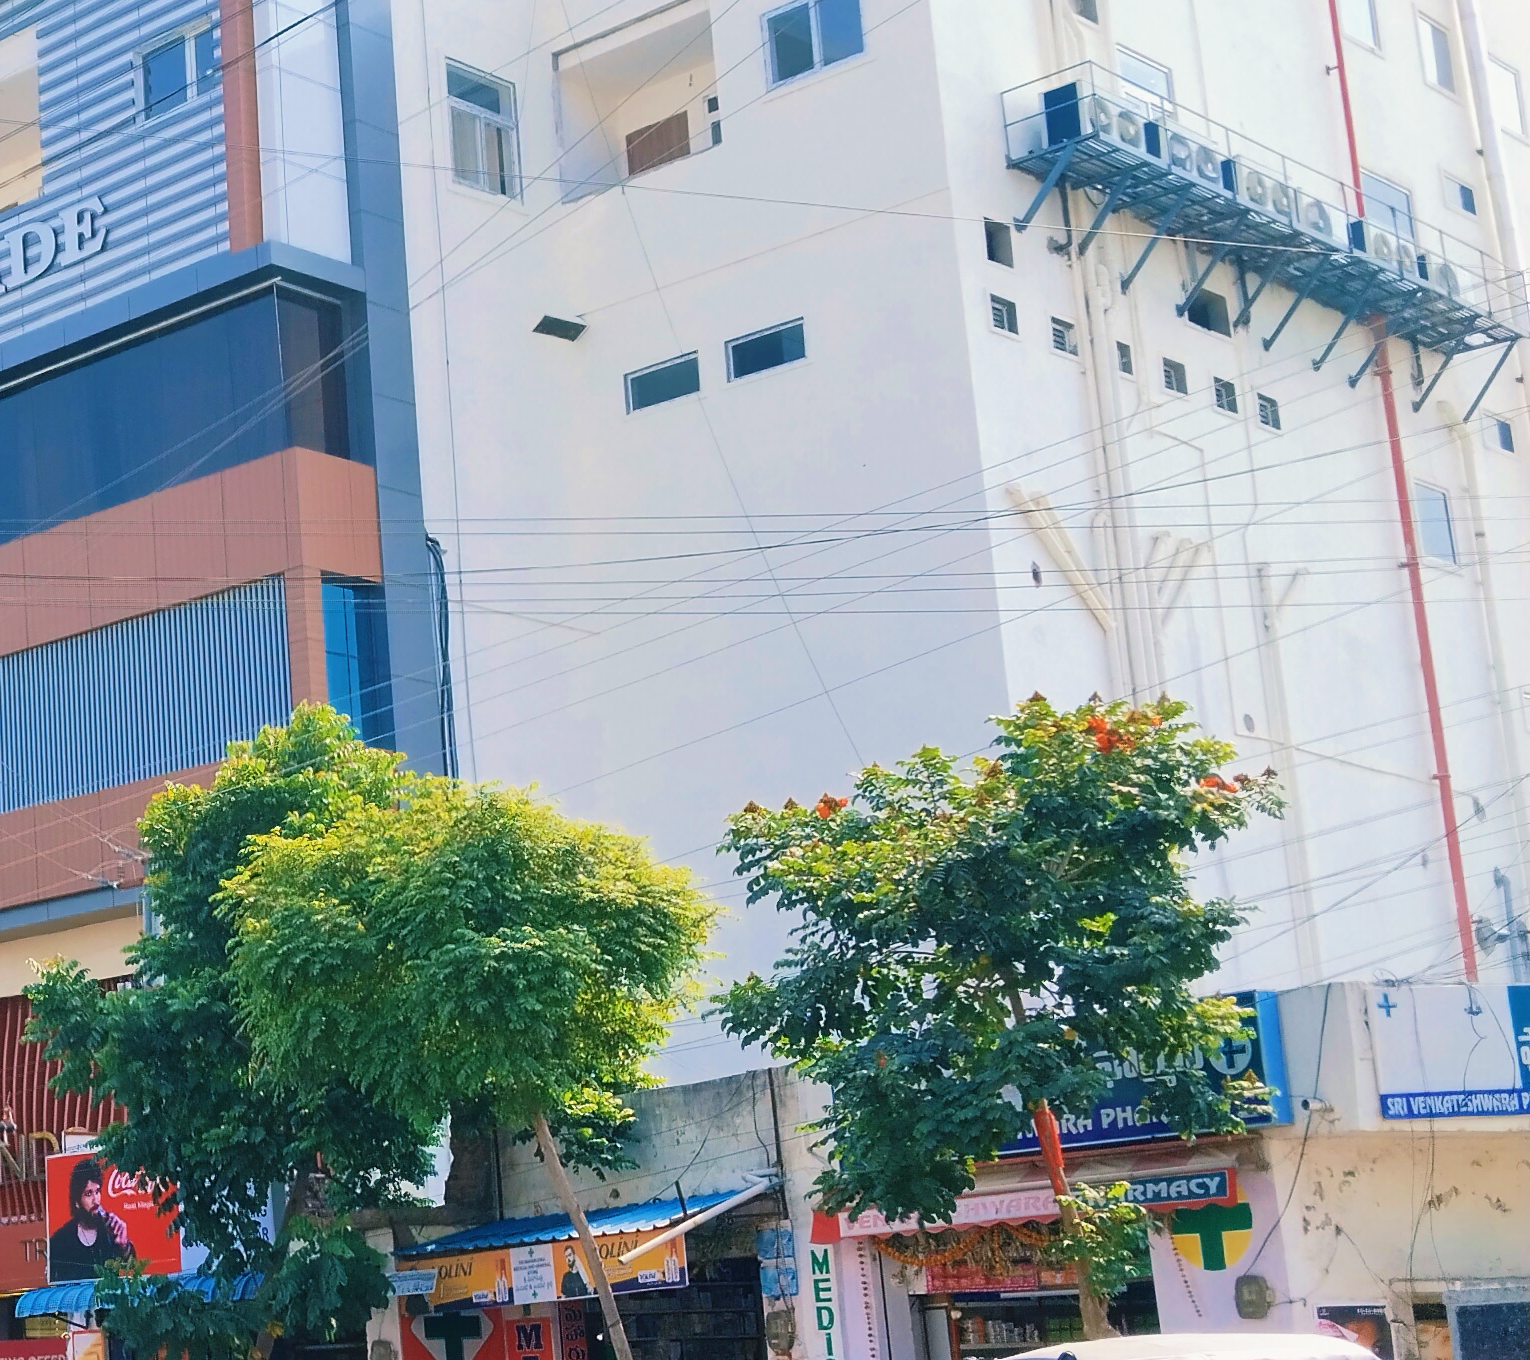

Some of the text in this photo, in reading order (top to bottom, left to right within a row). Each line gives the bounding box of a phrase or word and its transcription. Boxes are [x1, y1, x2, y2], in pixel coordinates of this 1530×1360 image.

[1387, 1097, 1408, 1117] SRI
[1073, 1177, 1221, 1206] RMACY
[599, 1234, 639, 1259] OLINI
